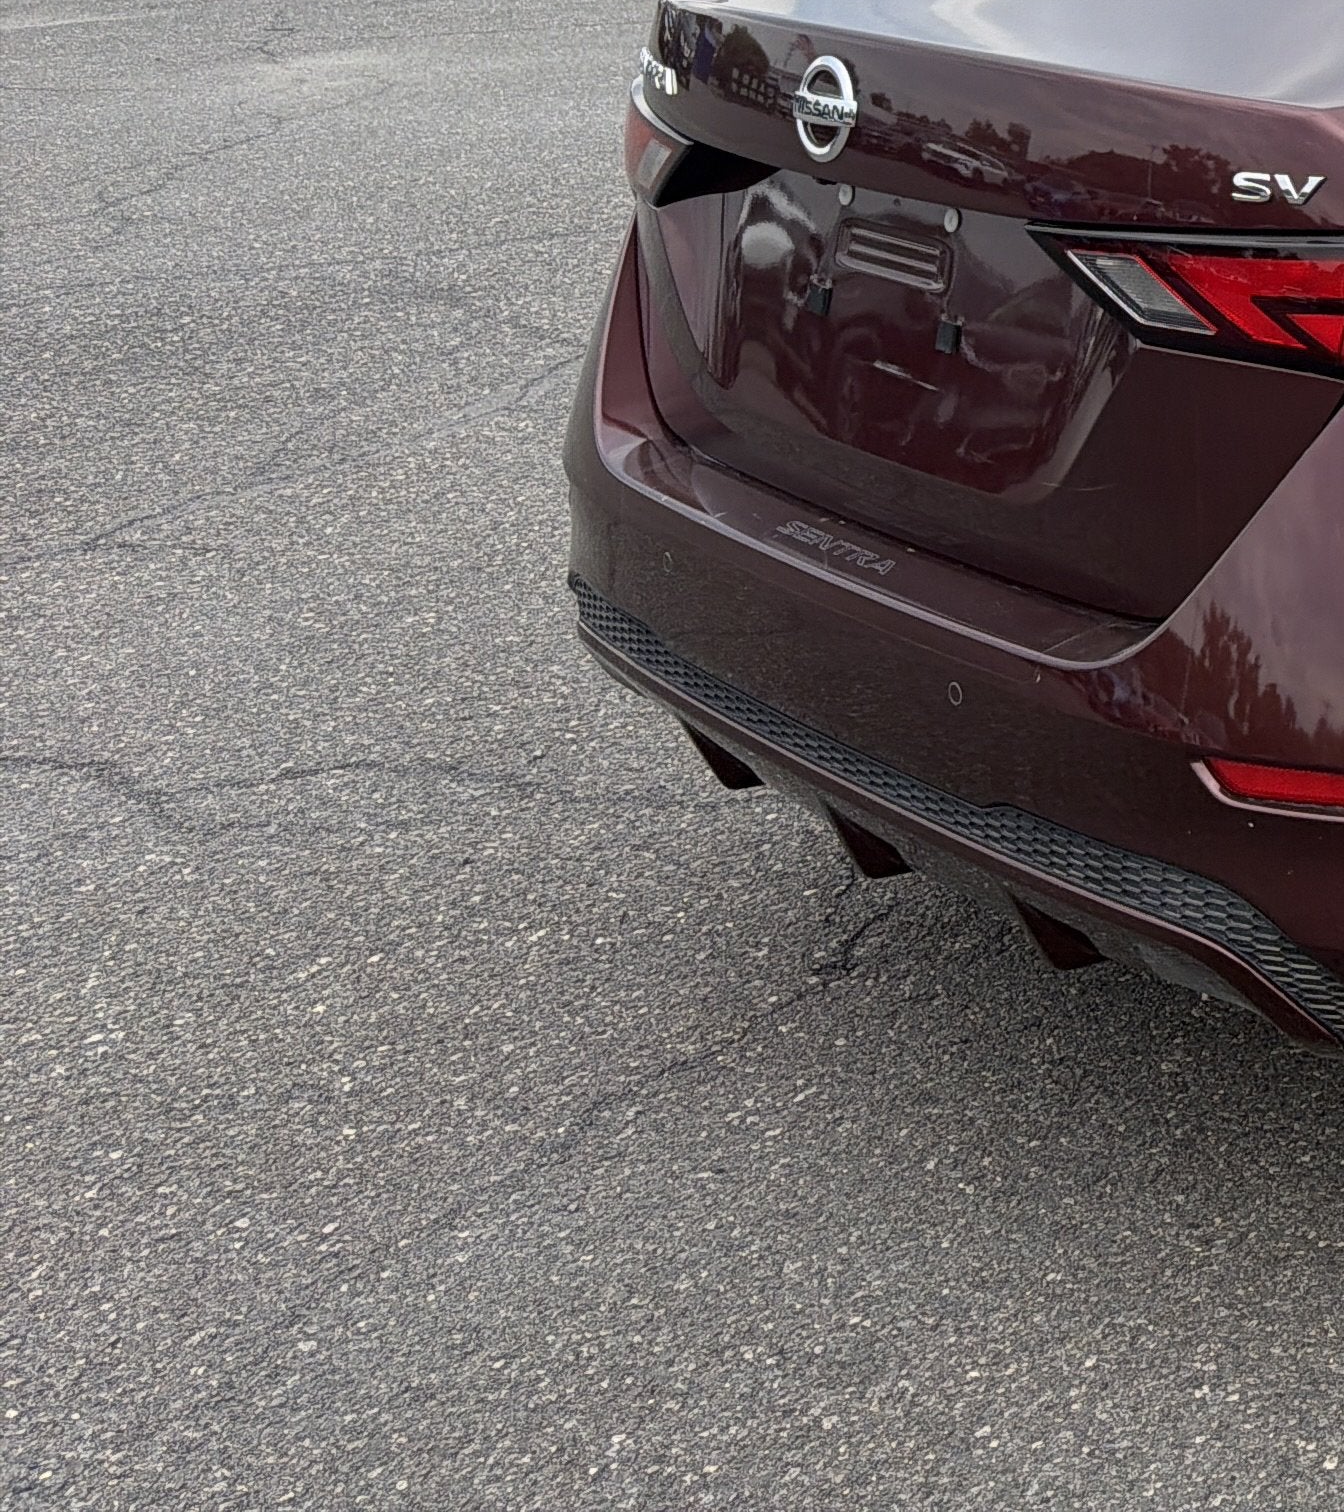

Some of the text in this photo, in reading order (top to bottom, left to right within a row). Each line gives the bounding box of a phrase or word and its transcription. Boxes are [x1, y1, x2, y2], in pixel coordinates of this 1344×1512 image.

[797, 94, 846, 122] NISSAN
[1232, 172, 1327, 205] SV
[776, 520, 896, 576] SENTRA
